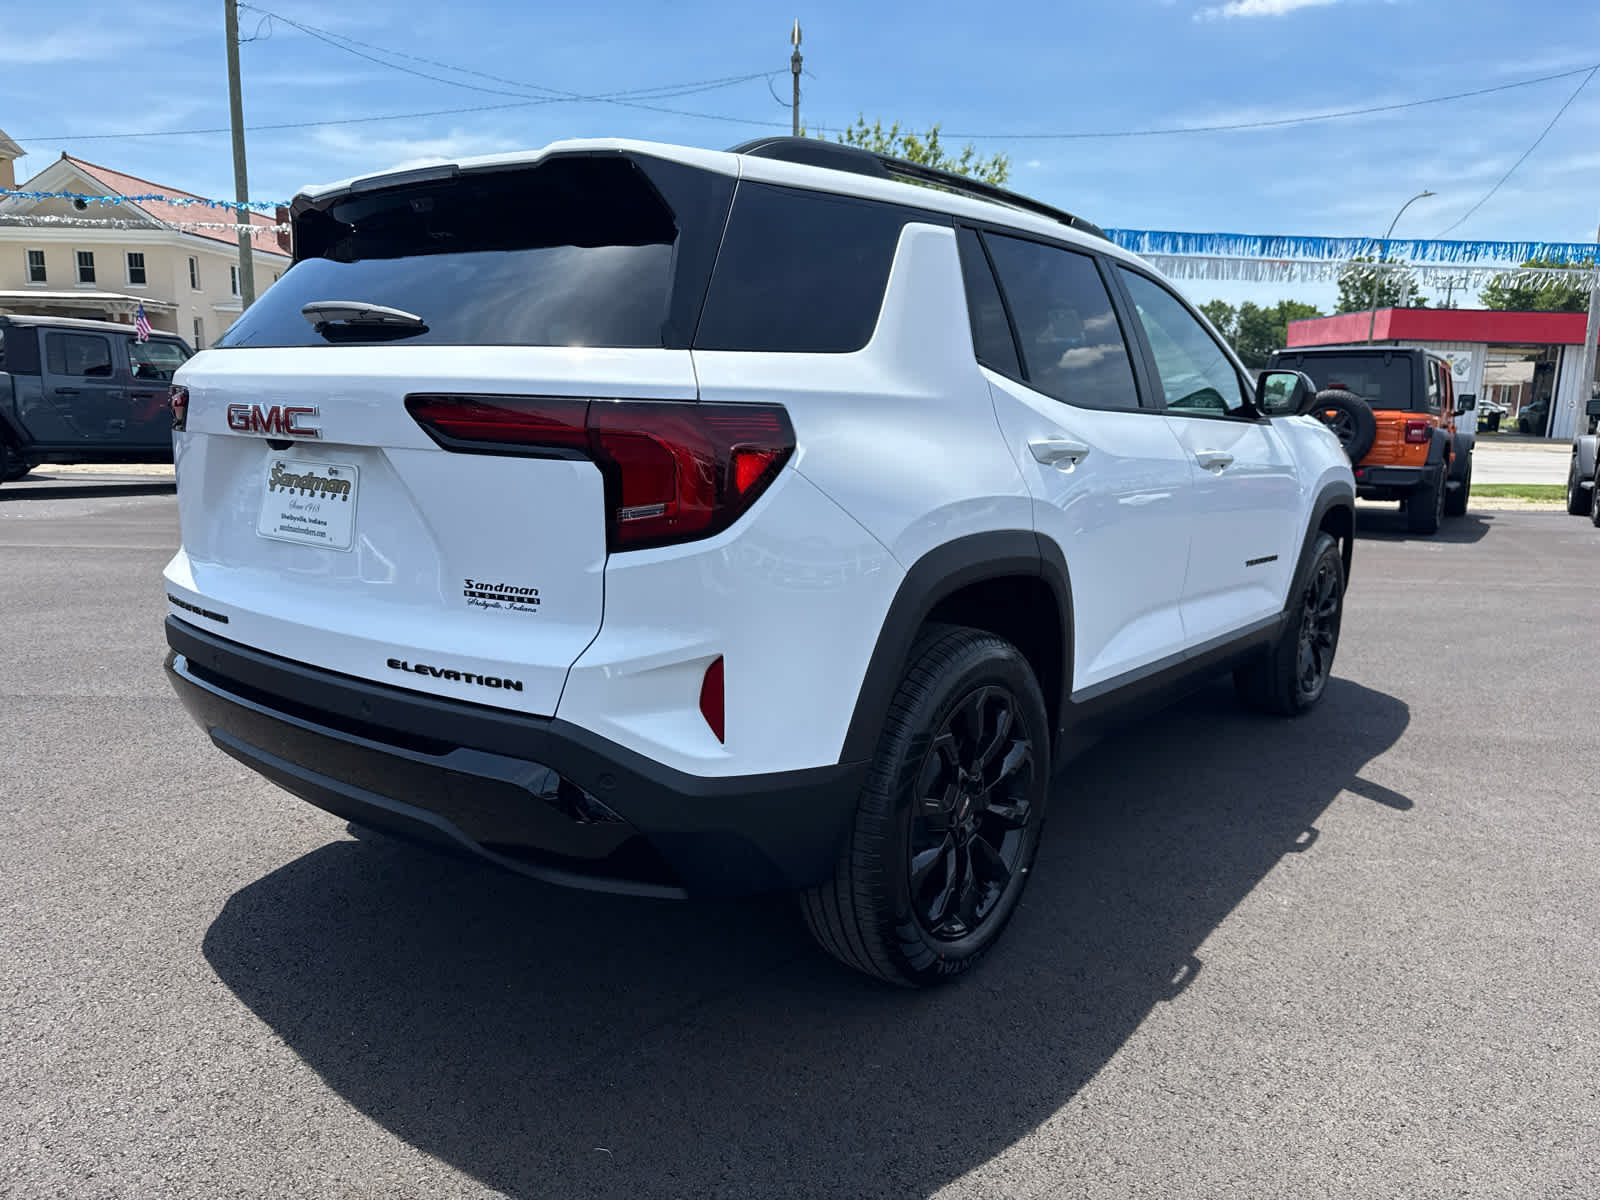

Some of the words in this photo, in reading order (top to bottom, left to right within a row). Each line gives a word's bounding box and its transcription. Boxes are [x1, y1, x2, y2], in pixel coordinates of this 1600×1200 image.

[227, 404, 321, 438] GMC
[269, 468, 351, 495] Sandman
[464, 579, 539, 596] Sandman
[387, 658, 523, 692] ELEVATION
